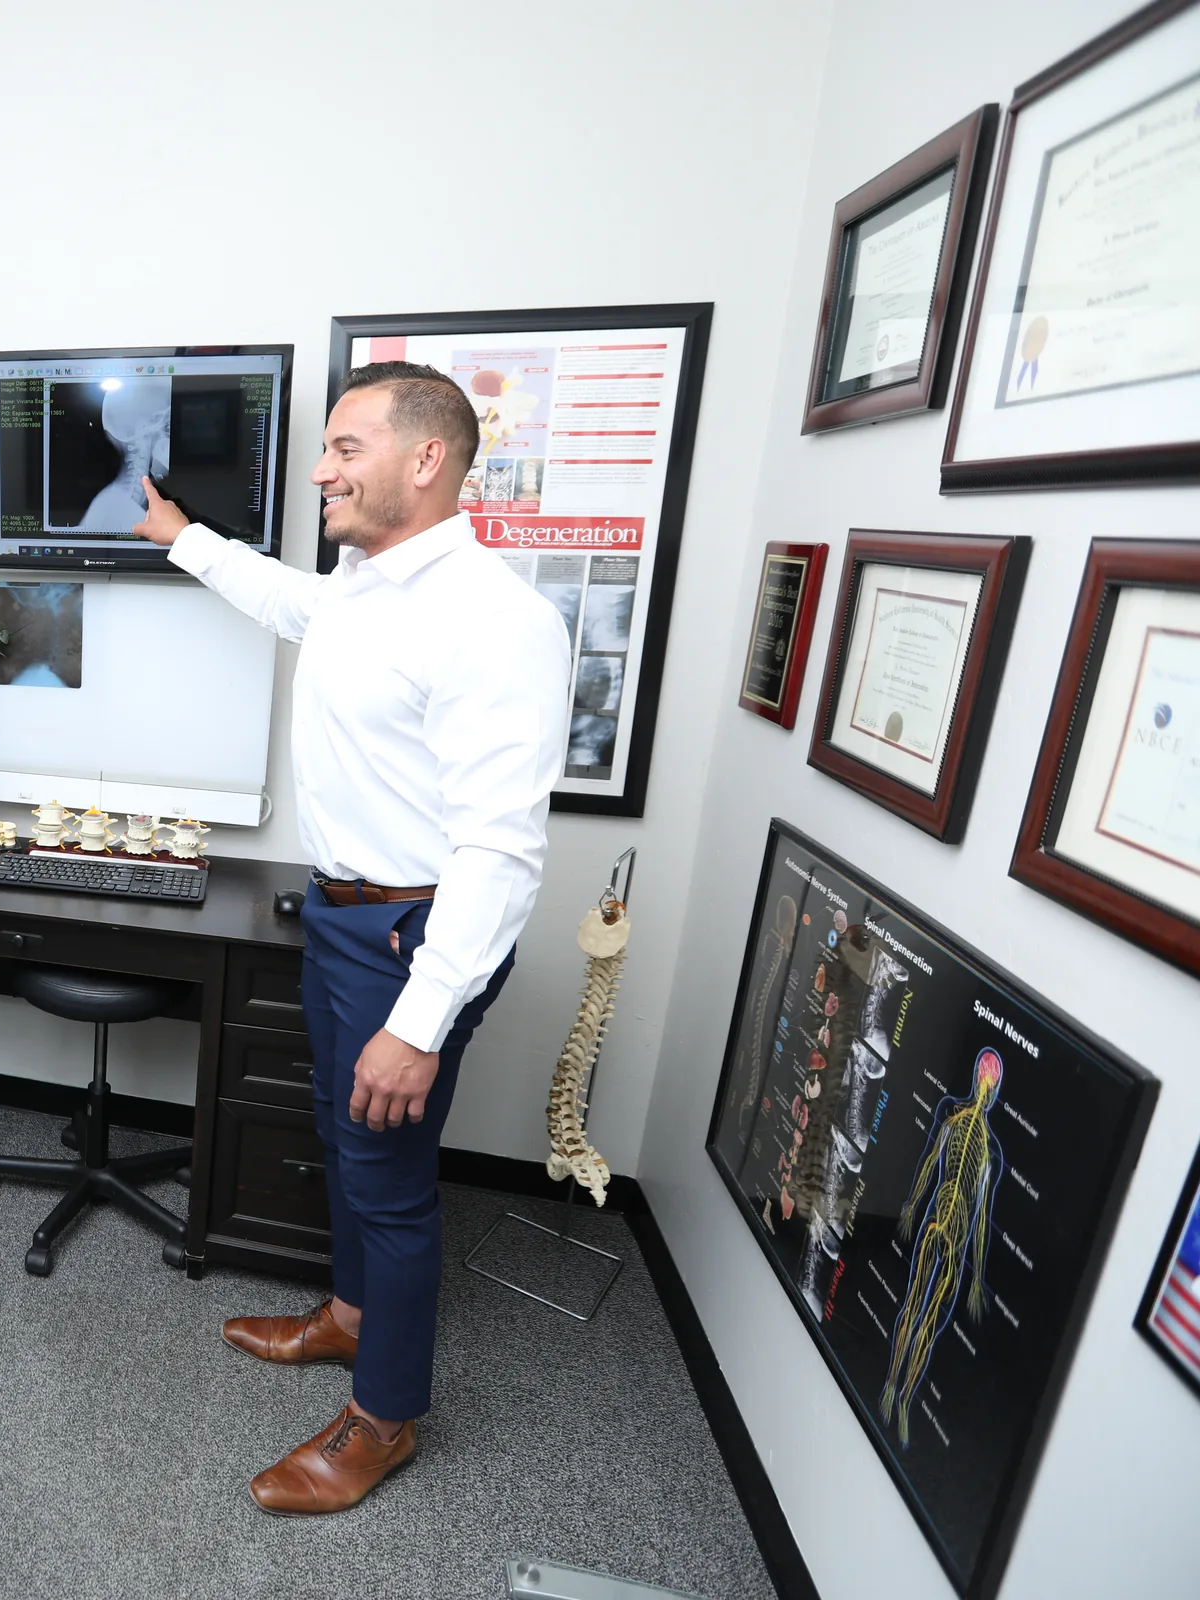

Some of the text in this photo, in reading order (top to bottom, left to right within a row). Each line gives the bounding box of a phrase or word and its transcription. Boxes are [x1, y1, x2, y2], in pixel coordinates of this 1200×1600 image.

[484, 518, 638, 548] Degeneration
[768, 613, 783, 628] 2016
[784, 857, 848, 910] Autonomic Nerve System
[864, 916, 933, 976] Spinal Degeneration
[892, 988, 913, 1048] Normal
[973, 1000, 1039, 1059] Spinal Nerves
[872, 1089, 889, 1132] Phase
[850, 1177, 865, 1220] Phase
[824, 1257, 846, 1321] Phase III
